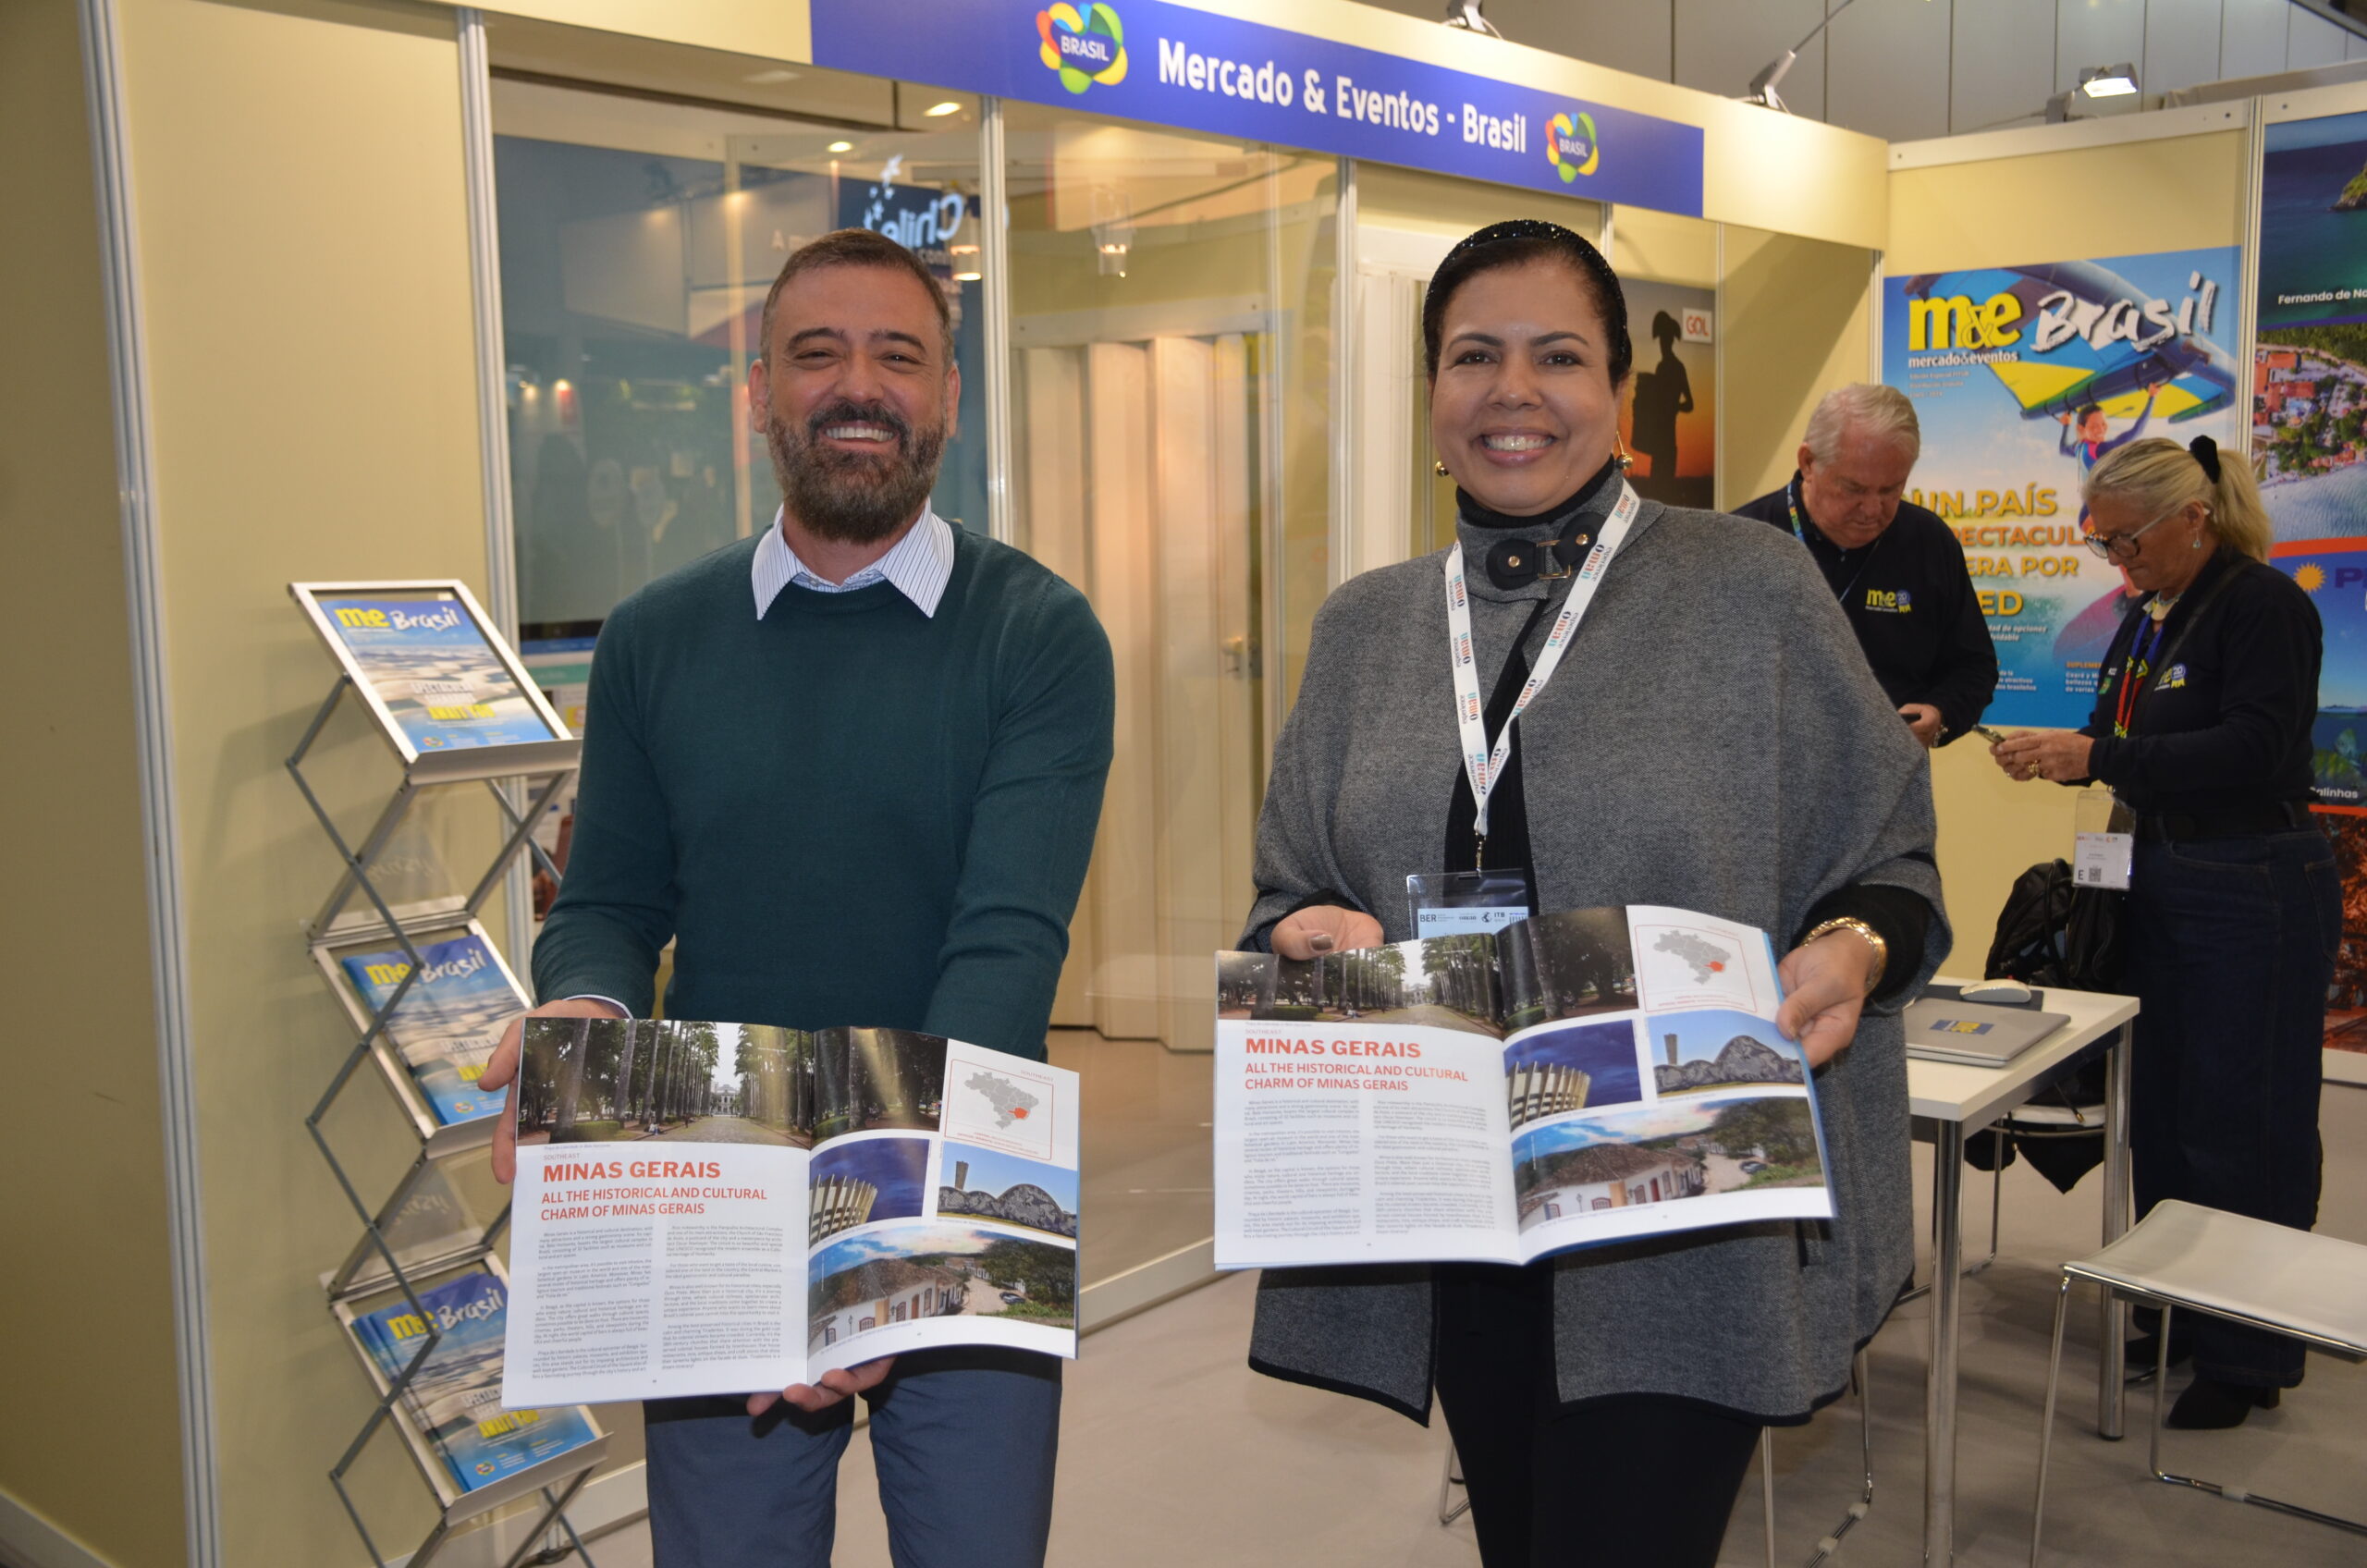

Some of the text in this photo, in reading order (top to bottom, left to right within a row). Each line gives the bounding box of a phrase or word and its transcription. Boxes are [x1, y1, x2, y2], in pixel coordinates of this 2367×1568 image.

[1060, 35, 1110, 61] BRASIL
[1158, 37, 1294, 106] Mercado
[1304, 68, 1327, 114] &
[1336, 75, 1439, 136] Eventos
[1463, 103, 1526, 153] Brasil
[1559, 137, 1588, 158] BRASIL
[2278, 291, 2334, 305] Fernando
[2336, 289, 2351, 300] de
[1908, 292, 2022, 351] m&e
[2030, 270, 2216, 355] Brasil
[1686, 315, 1709, 337] GOL
[1908, 350, 2018, 368] mercado&eventos
[1976, 482, 2058, 516] PAÍS
[1581, 544, 1604, 580] Oman
[1965, 557, 2079, 576] ERA POR
[1976, 590, 2024, 617] ED
[389, 606, 460, 631] Brasil
[1548, 611, 1571, 646] Oman
[1467, 692, 1478, 721] Oman
[2078, 869, 2084, 880] E
[1420, 914, 1437, 923] BER
[1245, 1038, 1421, 1058] MINAS GERAIS
[1245, 1062, 1468, 1082] ALL THE HISTORICAL AND CULTURAL
[1245, 1078, 1409, 1091] CHARM OF MINAS GERAIS
[544, 1161, 721, 1182] MINAS GERAIS
[542, 1187, 767, 1204] ALL THE HISTORICAL AND CULTURAL
[541, 1203, 705, 1221] CHARM OF MINAS GERAIS
[436, 1287, 504, 1329] Brasil
